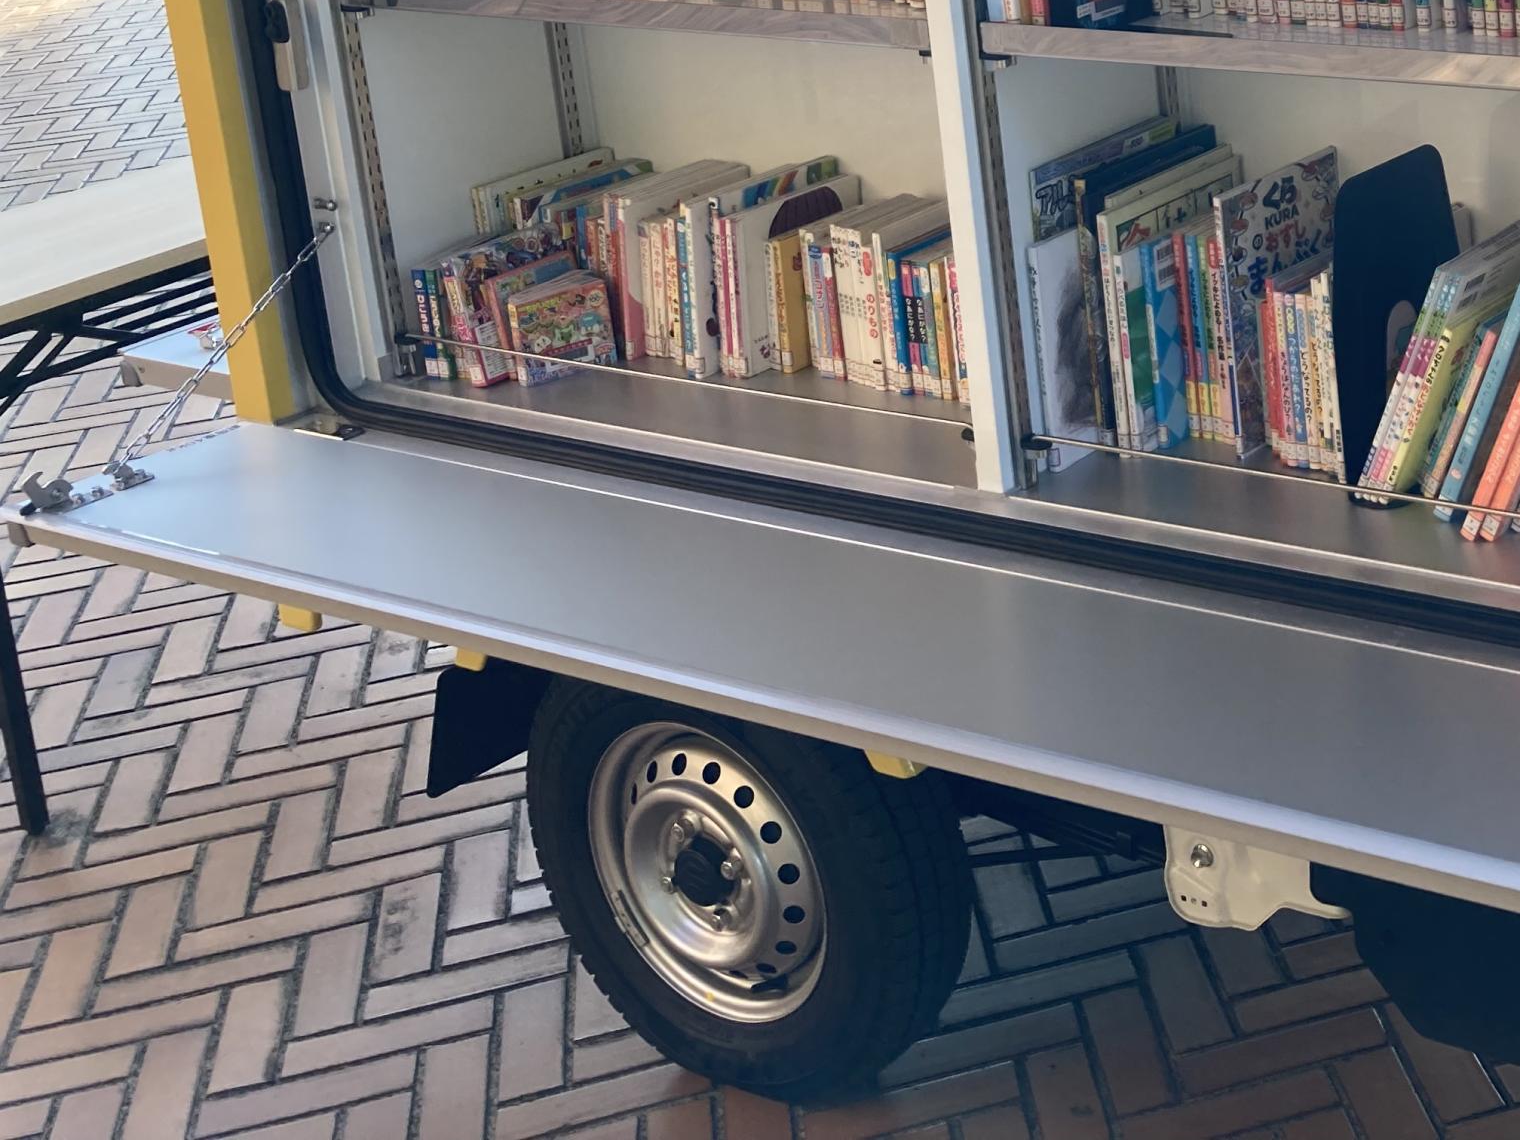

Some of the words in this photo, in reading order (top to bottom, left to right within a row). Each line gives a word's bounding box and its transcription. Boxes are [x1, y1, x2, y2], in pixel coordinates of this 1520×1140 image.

[1264, 204, 1301, 231] KURA
[867, 293, 881, 340] のりもの
